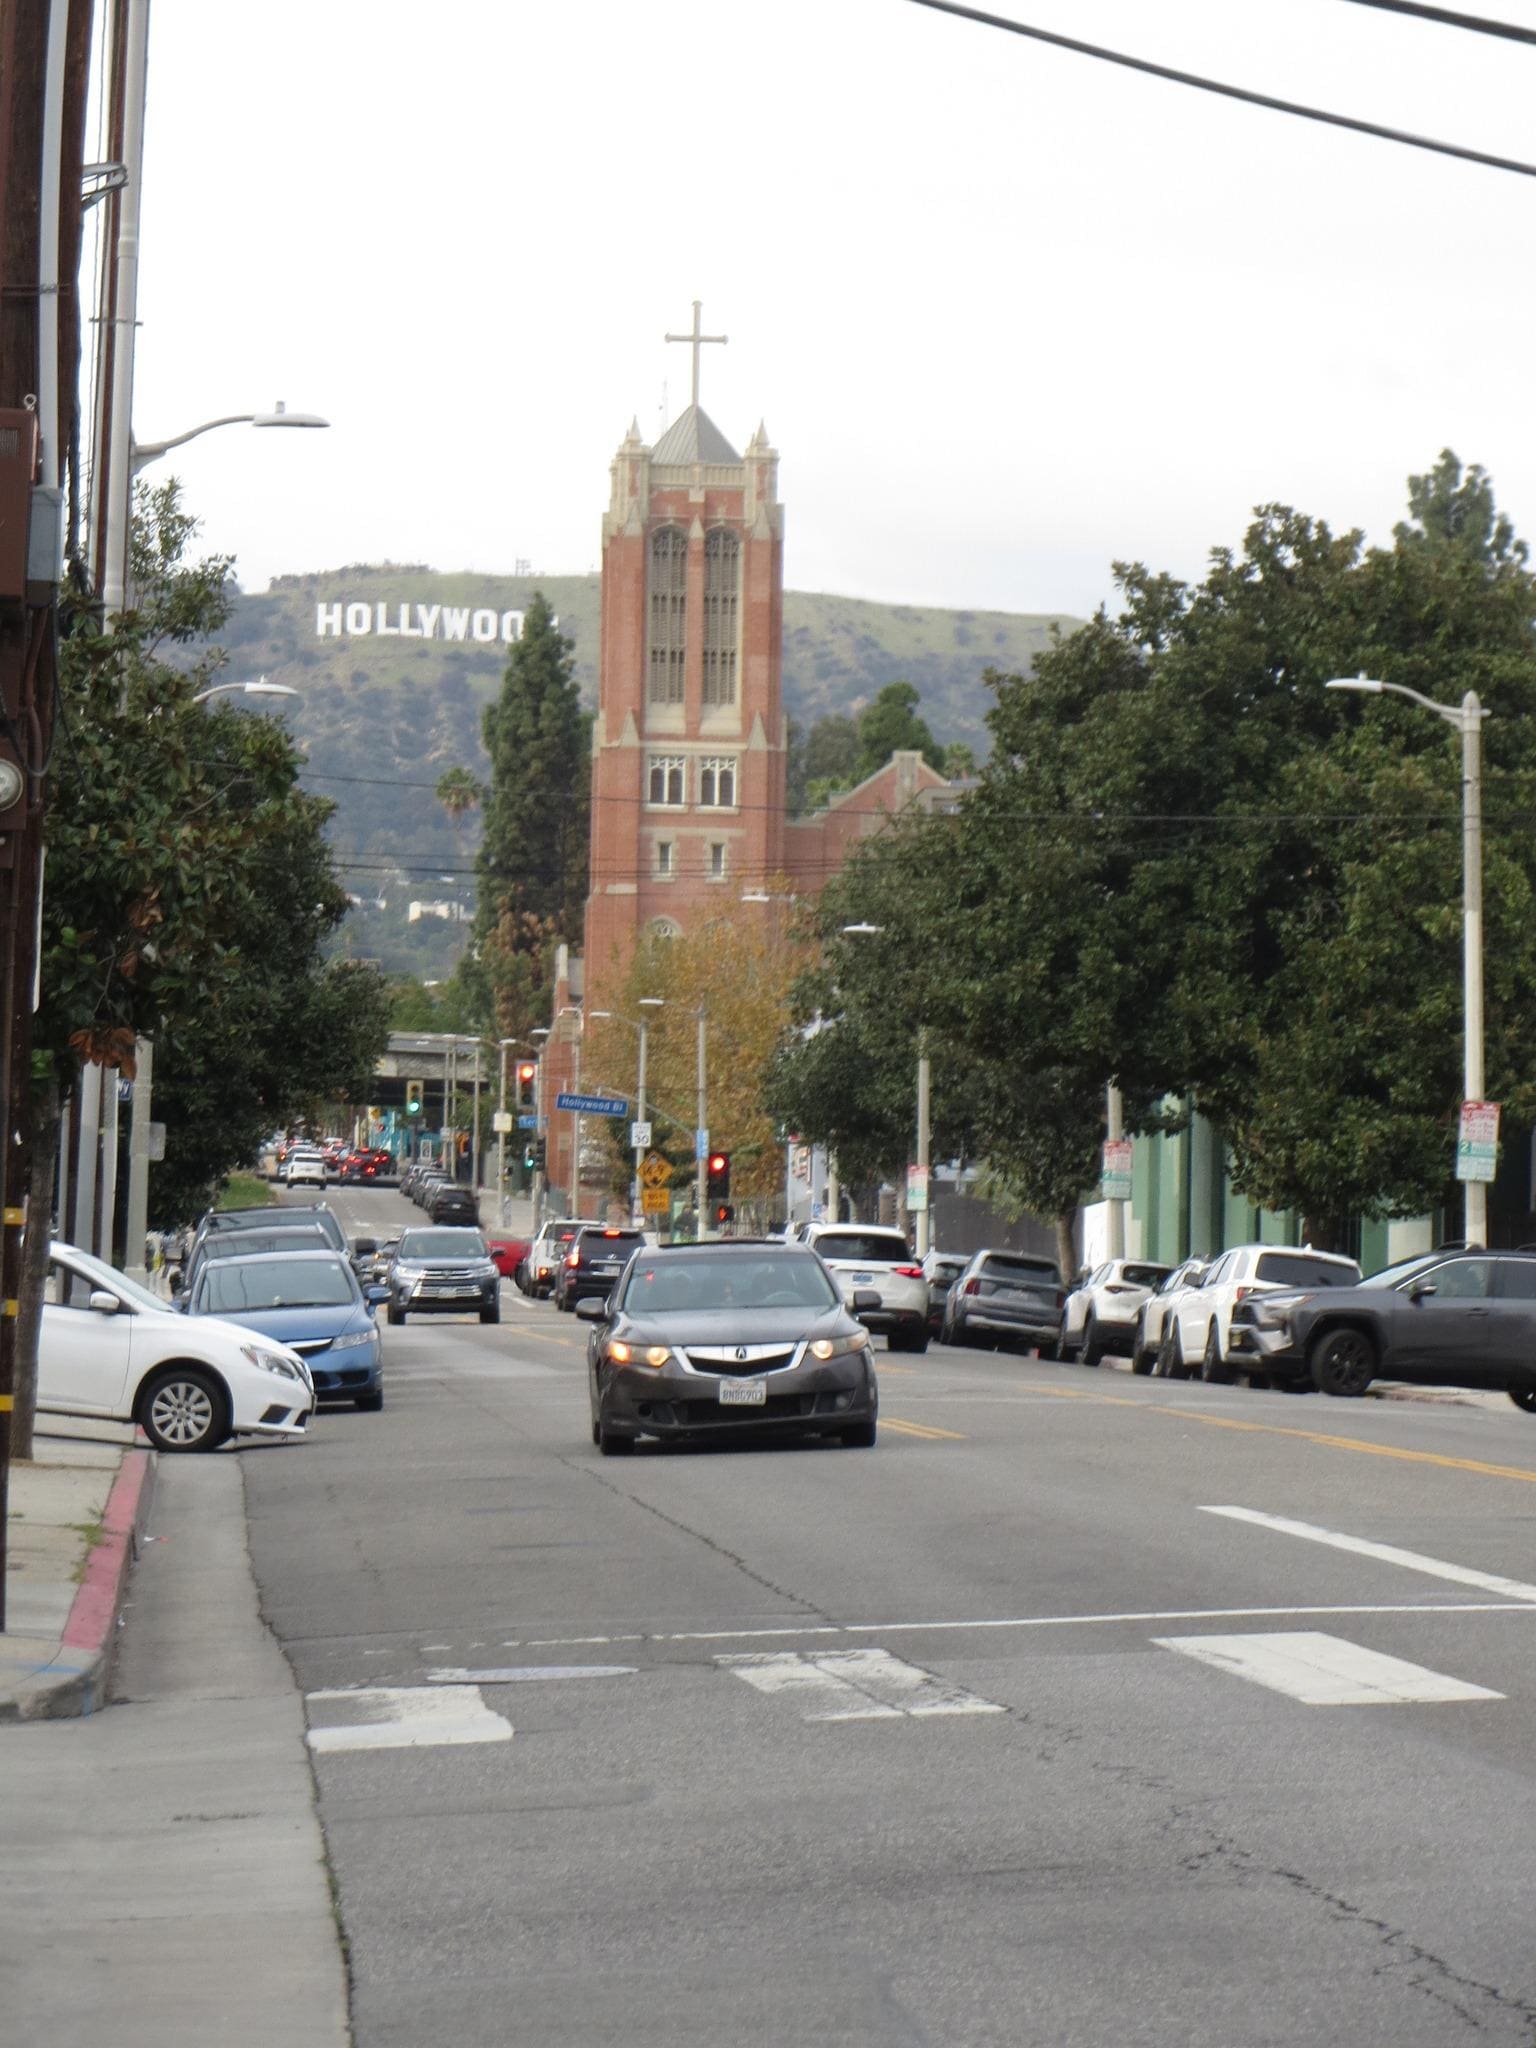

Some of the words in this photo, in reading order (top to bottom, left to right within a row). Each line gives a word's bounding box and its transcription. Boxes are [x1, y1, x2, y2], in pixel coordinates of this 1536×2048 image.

[316, 602, 559, 643] HOLLYWOO
[561, 1096, 610, 1110] Hollywood
[612, 1101, 624, 1111] Bl
[634, 1135, 649, 1144] 30
[1460, 1142, 1469, 1153] 2
